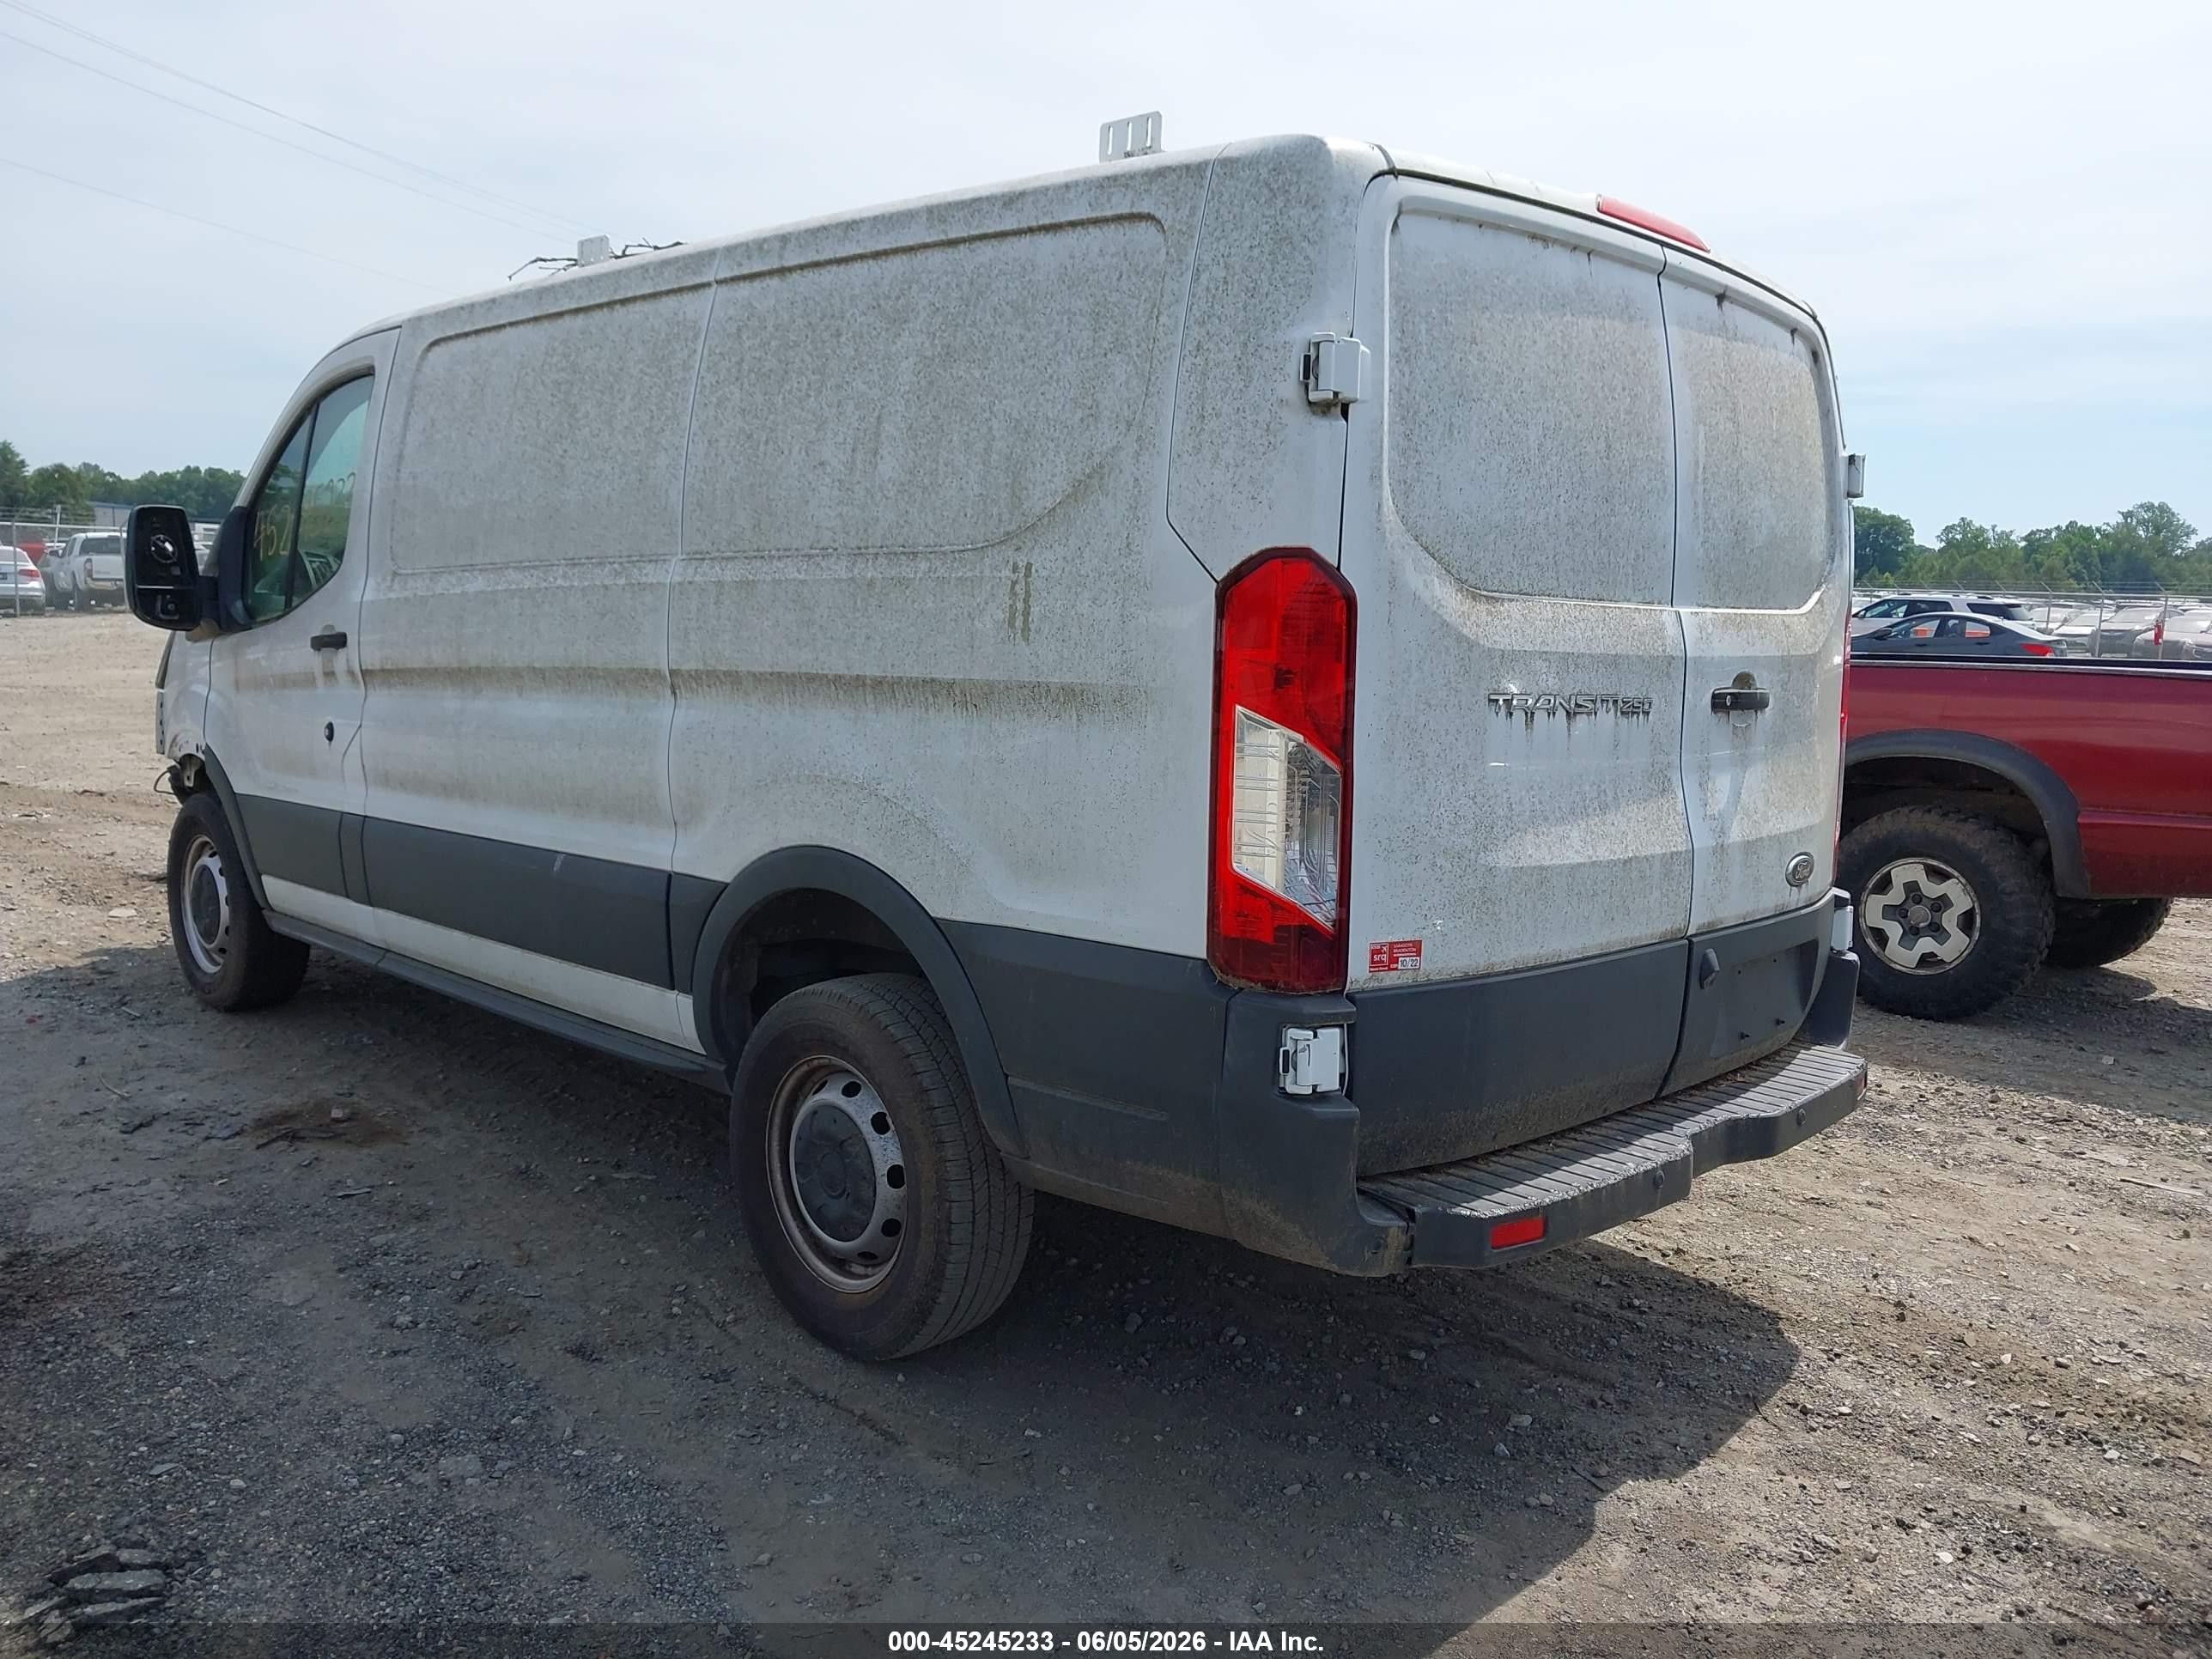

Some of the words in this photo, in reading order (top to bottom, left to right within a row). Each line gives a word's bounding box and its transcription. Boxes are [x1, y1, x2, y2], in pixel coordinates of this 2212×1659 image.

[1488, 694, 1623, 714] TRANSIT
[1374, 954, 1387, 963] srq
[1400, 958, 1419, 968] 10/22
